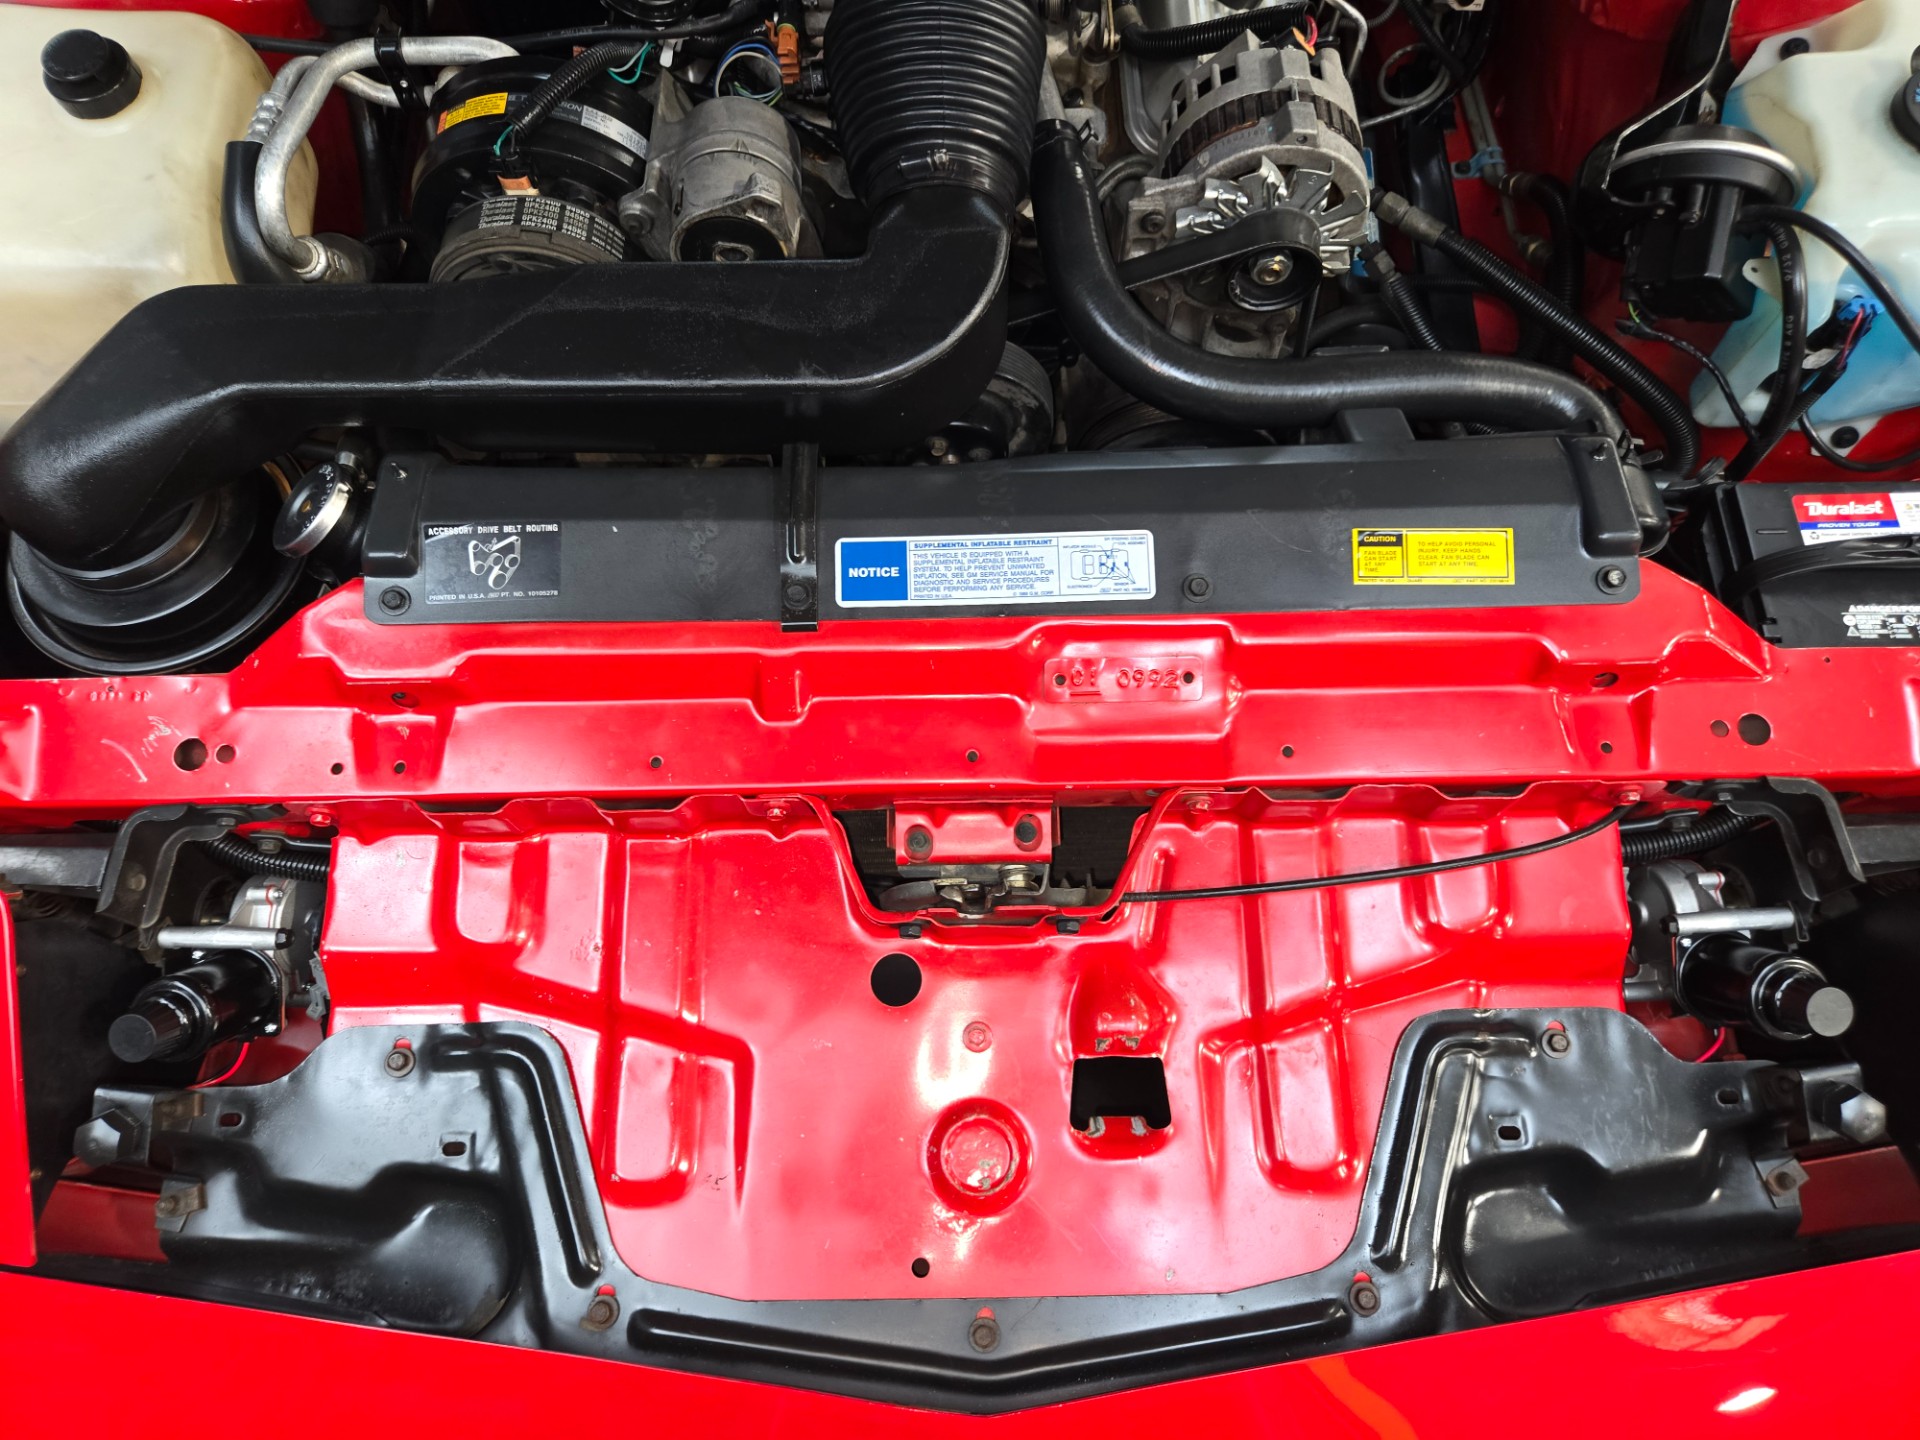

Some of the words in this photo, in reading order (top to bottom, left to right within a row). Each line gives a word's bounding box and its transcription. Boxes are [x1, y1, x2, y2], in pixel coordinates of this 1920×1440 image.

[523, 208, 559, 219] 6PK2400
[525, 202, 560, 213] 6PK2400
[565, 210, 589, 224] 945K6
[480, 214, 515, 223] Duralast
[522, 214, 557, 226] 6PK2400
[563, 222, 587, 236] 945K6
[1803, 500, 1884, 516] Duralast
[428, 526, 473, 536] ACCESSORY
[526, 524, 558, 532] ROUTING
[848, 567, 900, 578] NOTICE
[1116, 668, 1179, 689] 0992
